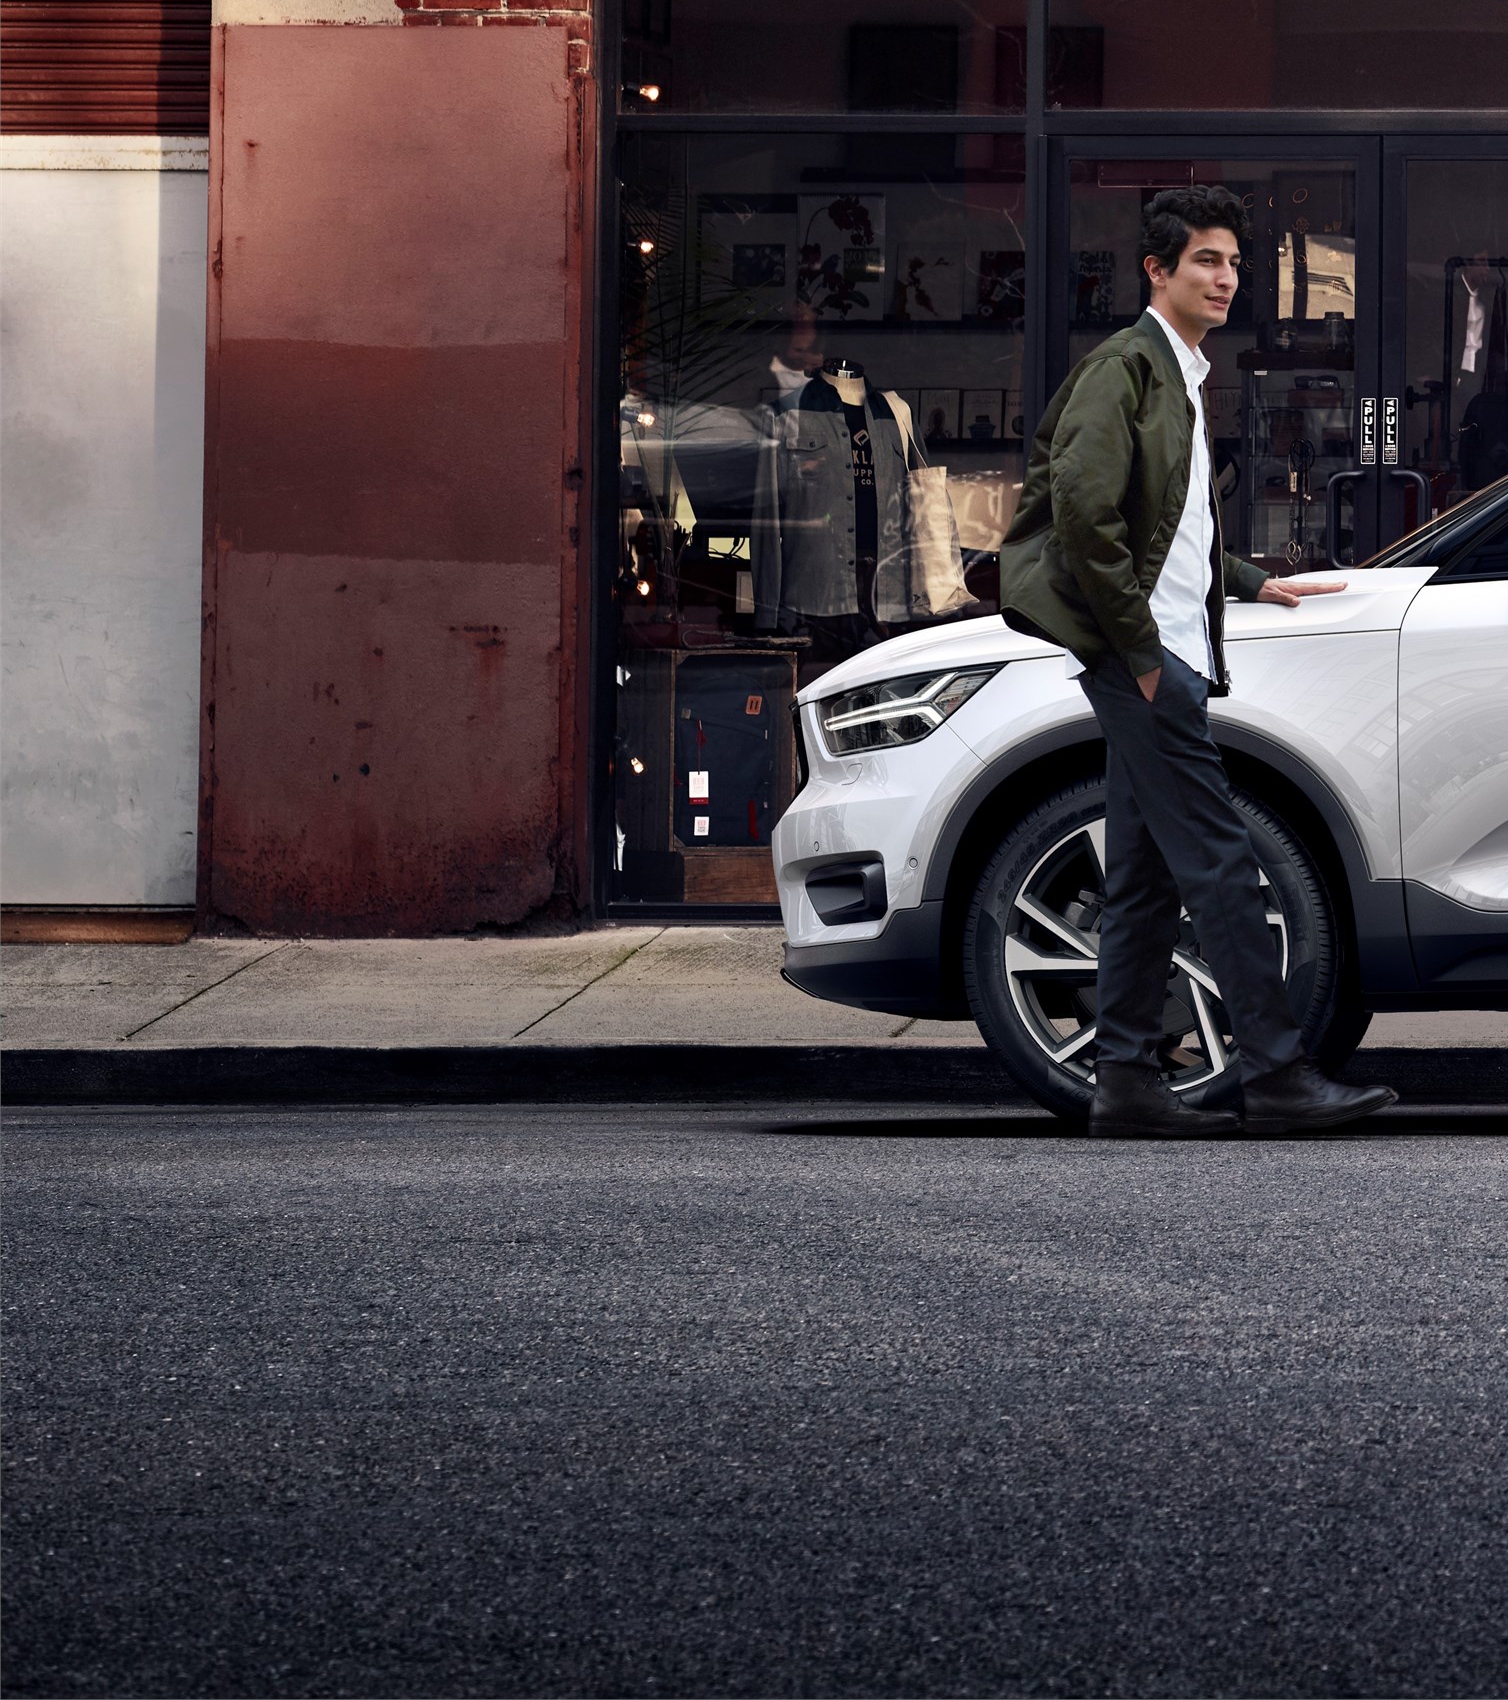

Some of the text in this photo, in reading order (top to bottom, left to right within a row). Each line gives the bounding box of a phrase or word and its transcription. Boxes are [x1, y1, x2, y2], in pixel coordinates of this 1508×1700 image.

[1363, 406, 1373, 444] PULL
[1385, 406, 1396, 444] PULL
[853, 469, 873, 477] UPP
